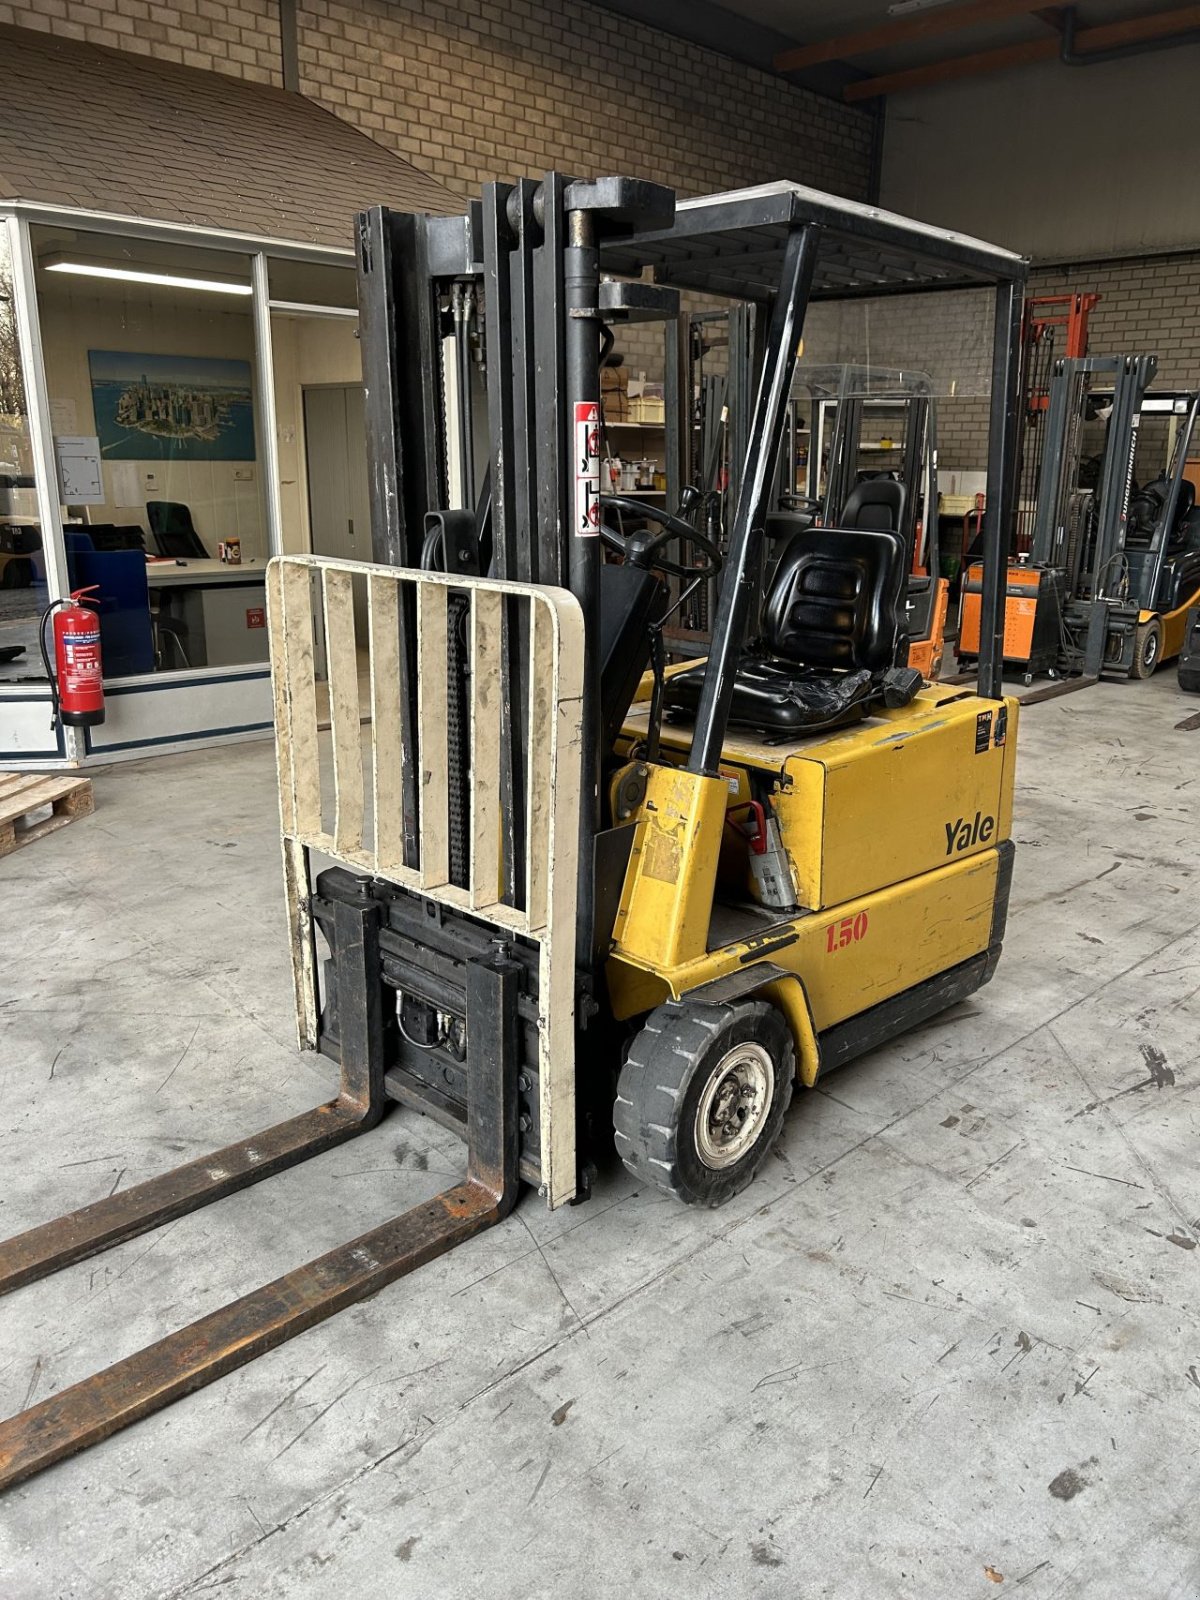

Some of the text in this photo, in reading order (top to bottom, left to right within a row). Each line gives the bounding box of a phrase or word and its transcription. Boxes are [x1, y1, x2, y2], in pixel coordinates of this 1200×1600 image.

[1121, 430, 1137, 521] JUNGHEINRICH
[945, 811, 995, 856] Yale
[826, 911, 869, 953] 1.50
